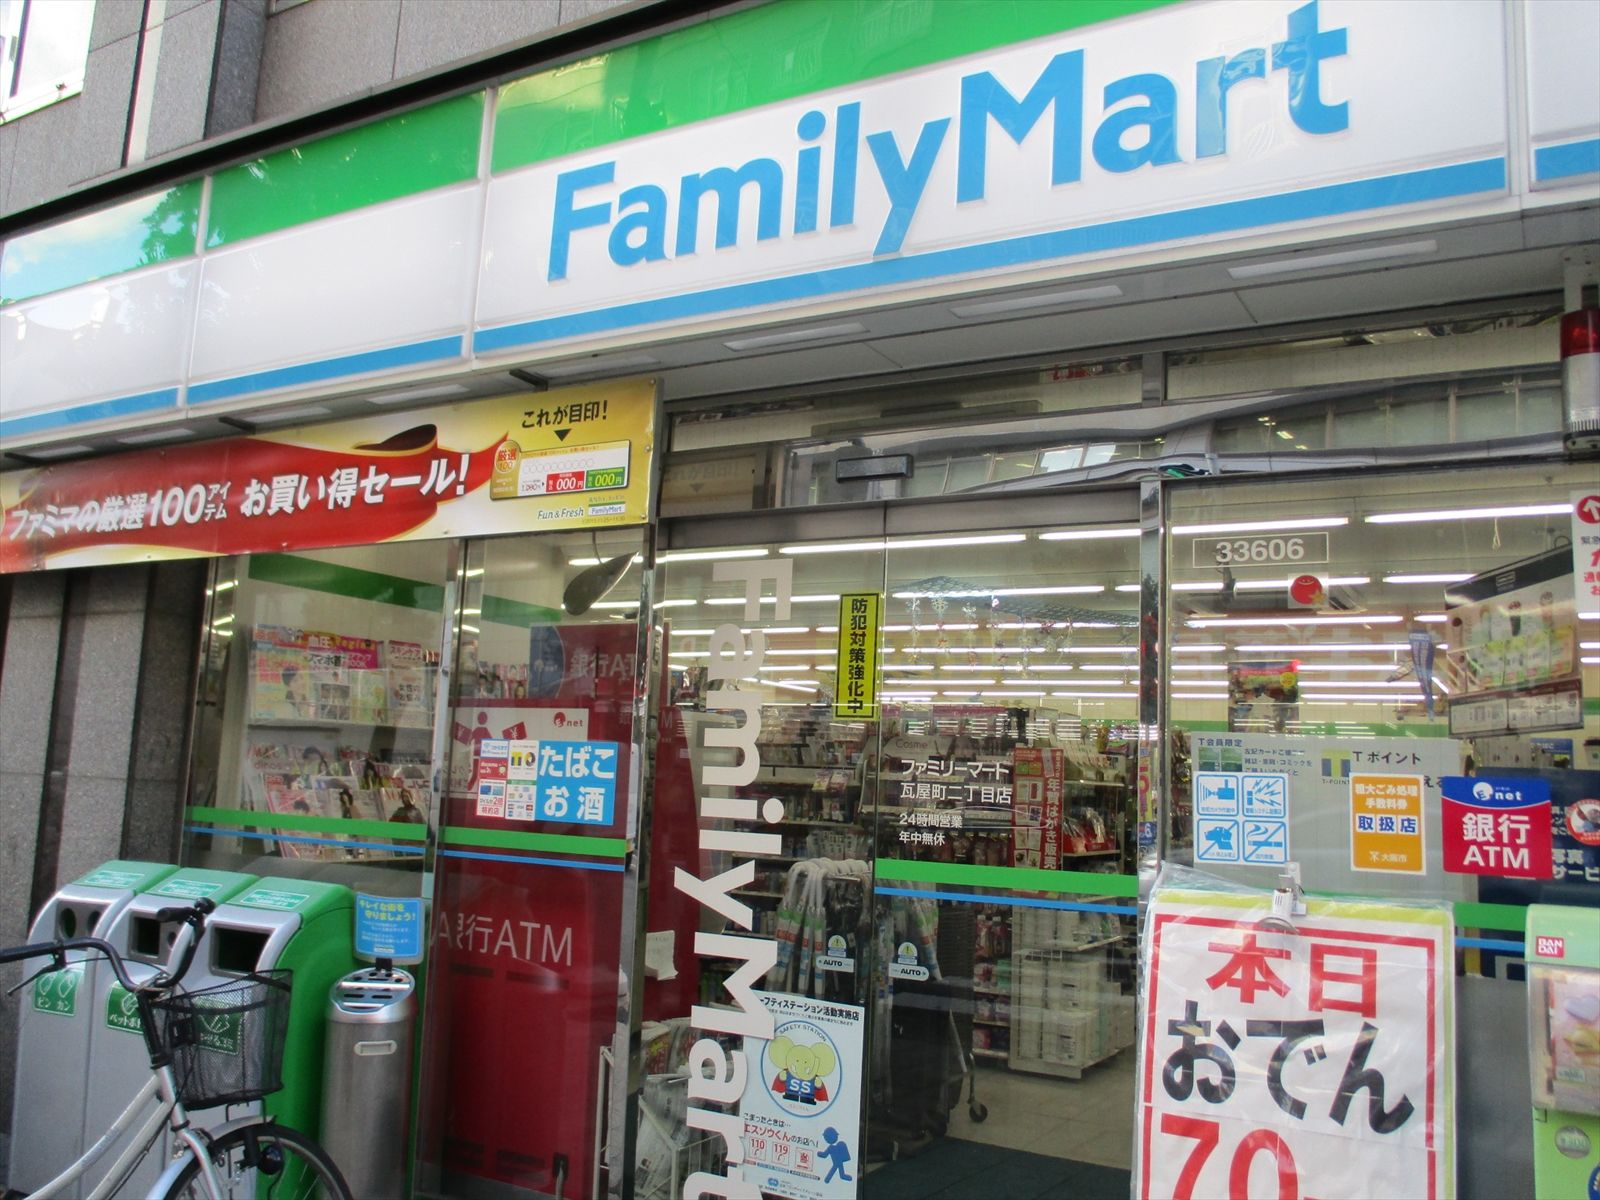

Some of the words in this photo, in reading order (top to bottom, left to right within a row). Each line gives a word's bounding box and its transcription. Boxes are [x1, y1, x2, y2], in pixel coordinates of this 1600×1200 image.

[546, 0, 1350, 283] FamilyMart
[522, 400, 608, 429] これが目印!
[1215, 538, 1304, 562] 33606
[847, 598, 868, 714] 防犯対策強化中
[895, 740, 928, 749] Cosme
[539, 745, 615, 779] たばこ
[901, 759, 1010, 780] ファミリーマート
[543, 786, 606, 821] お酒
[900, 782, 1012, 805] 瓦屋町二丁目店
[899, 813, 963, 829] 24時間営業
[1357, 815, 1417, 834] 取扱店
[1461, 812, 1530, 844] 銀行
[898, 831, 945, 846] 年中無休
[1463, 845, 1530, 869] ATM
[674, 558, 793, 1200] FamilyMart
[1538, 937, 1563, 947] BAN
[823, 959, 843, 967] AUTO
[900, 968, 921, 976] AUTO
[1206, 933, 1379, 1019] 本日
[779, 1023, 801, 1035] SAFETY
[1161, 1000, 1415, 1135] おでん
[789, 1079, 812, 1094] SS
[751, 1138, 765, 1150] 110
[774, 1143, 788, 1155] 119
